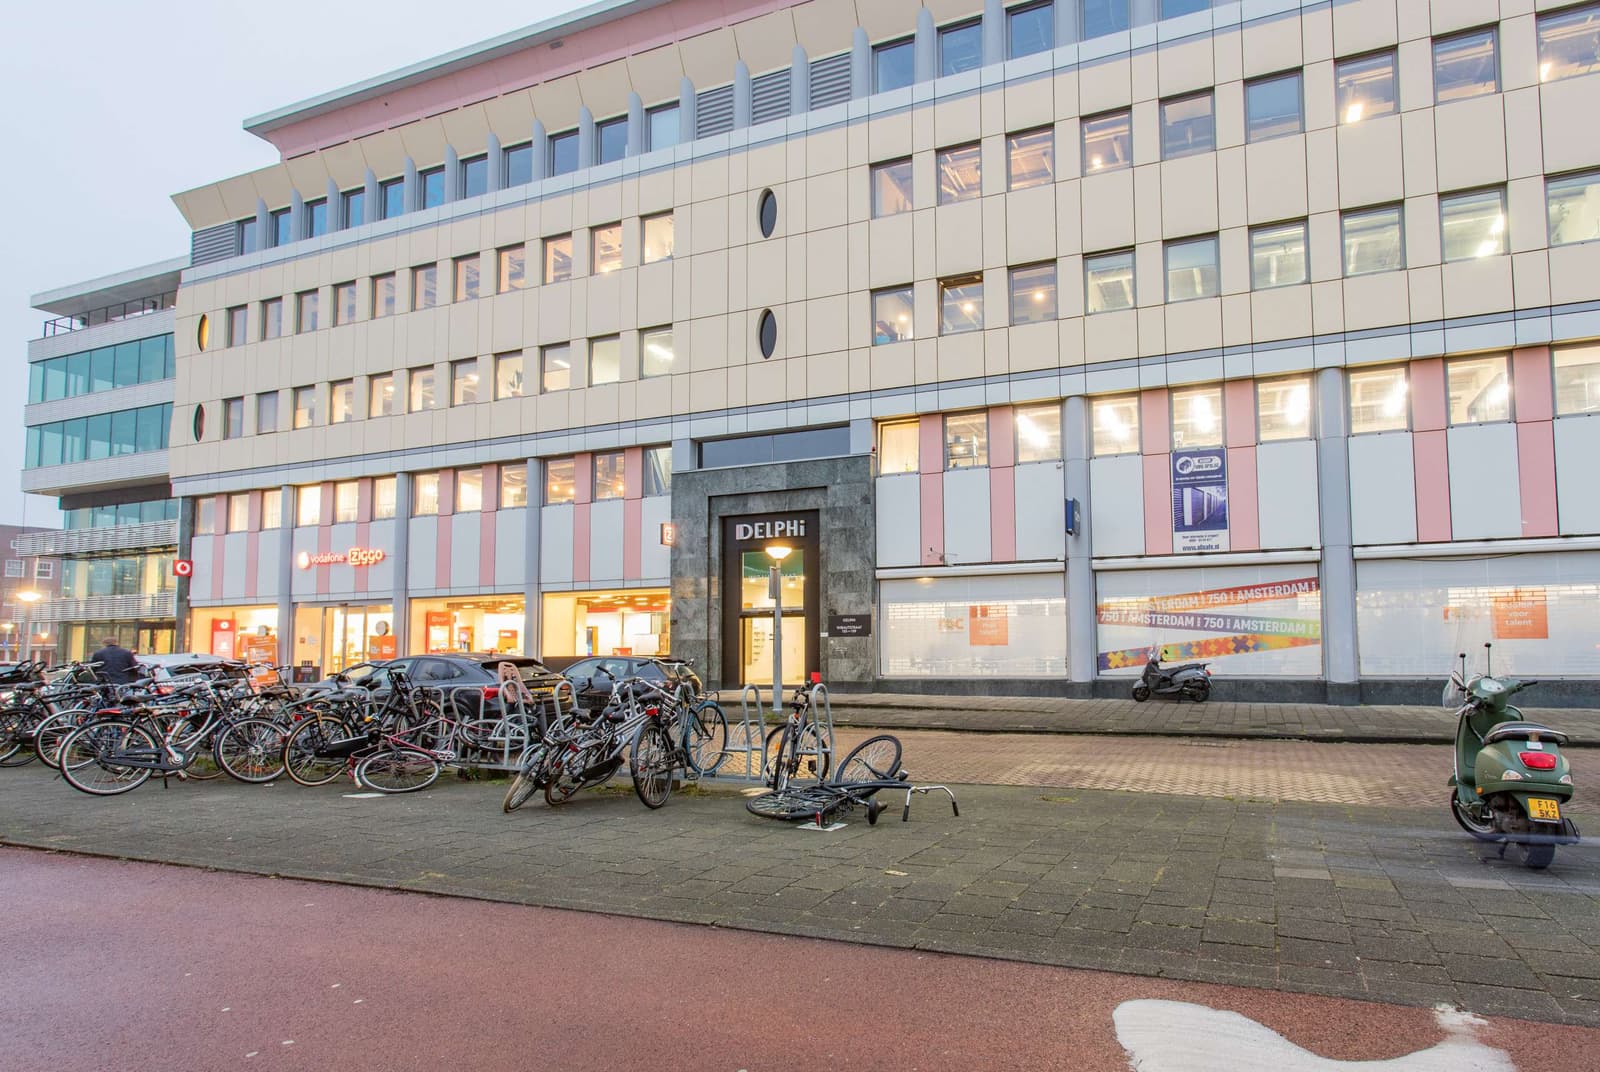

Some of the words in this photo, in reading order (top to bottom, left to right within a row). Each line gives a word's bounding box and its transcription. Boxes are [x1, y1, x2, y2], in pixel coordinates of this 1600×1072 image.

[310, 552, 345, 564] vodafone
[1208, 592, 1227, 604] 750
[1237, 581, 1309, 601] AMSTERDAM
[1100, 611, 1119, 622] 750
[1127, 611, 1194, 627] AMSTERDAM
[1204, 617, 1224, 628] 750
[1233, 618, 1305, 633] AMSTERDAM
[1537, 800, 1555, 810] F16
